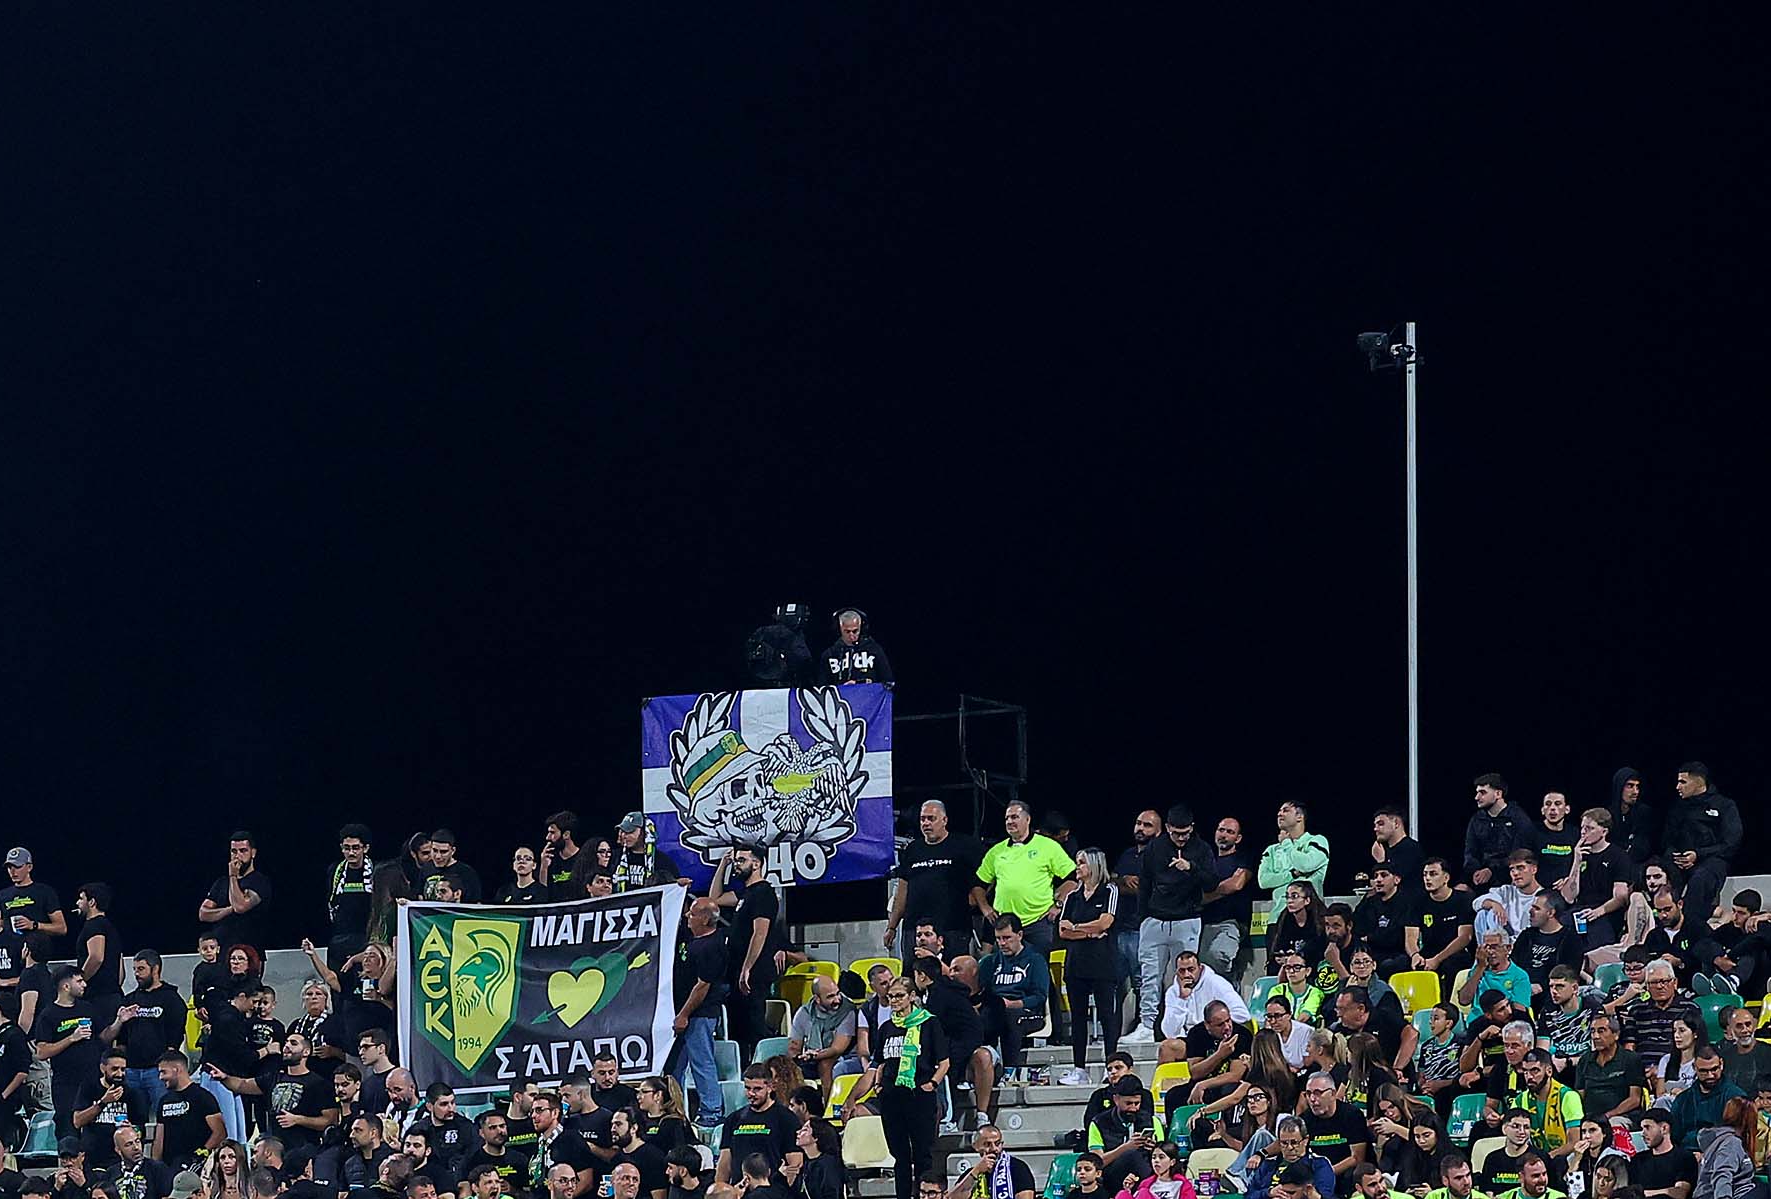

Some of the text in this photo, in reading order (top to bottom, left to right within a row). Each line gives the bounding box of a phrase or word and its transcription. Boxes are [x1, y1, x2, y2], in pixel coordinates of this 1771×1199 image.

[709, 841, 827, 885] 740
[530, 904, 658, 947] ΜΑΓΙΣΣΑ
[458, 1037, 482, 1050] 1994
